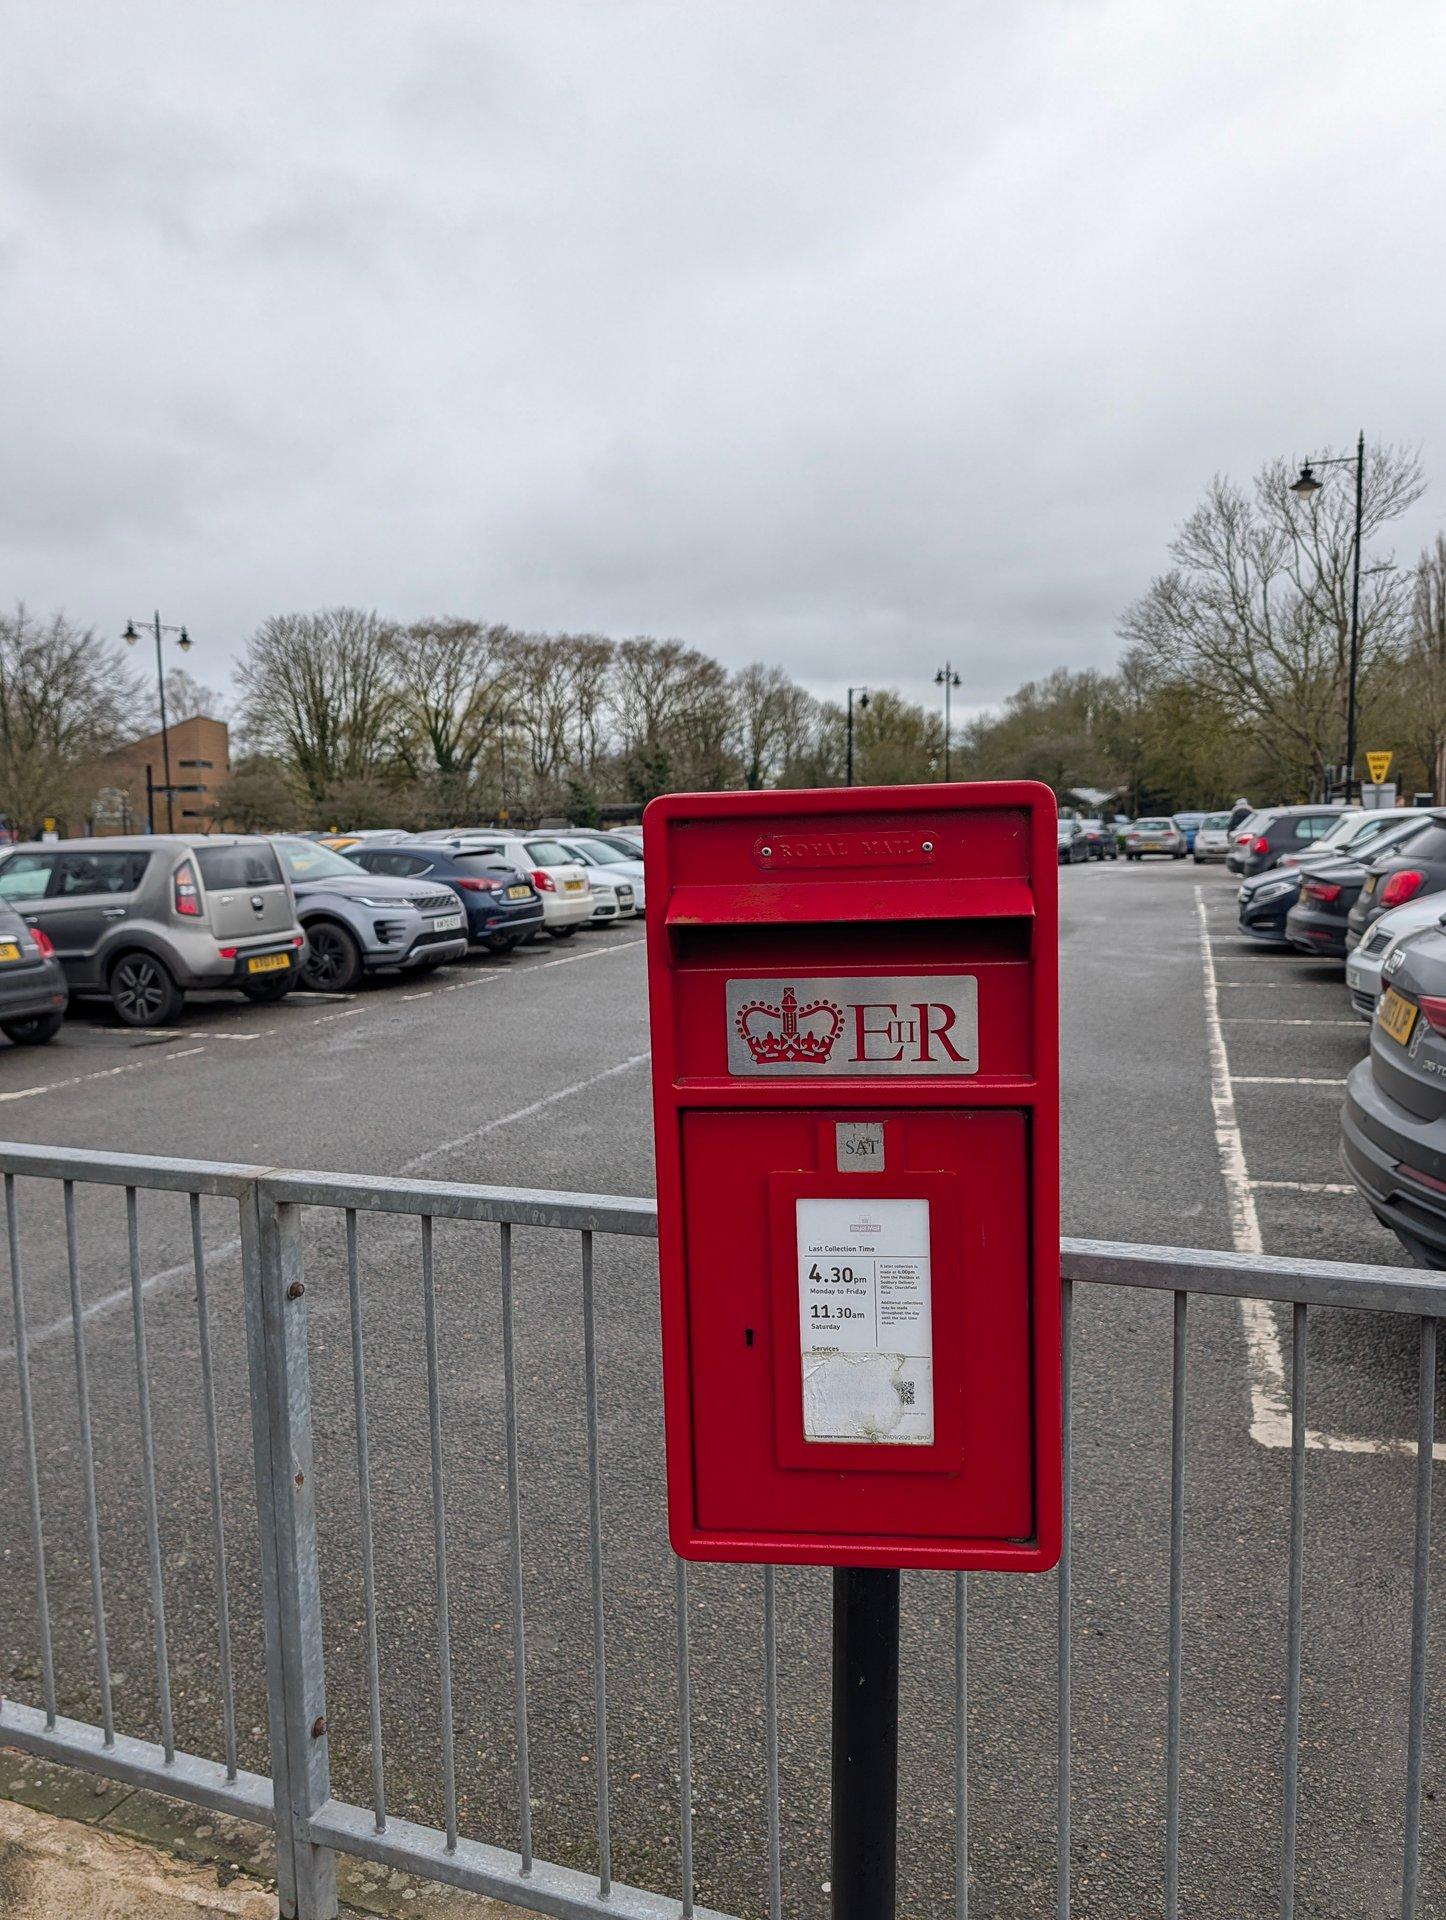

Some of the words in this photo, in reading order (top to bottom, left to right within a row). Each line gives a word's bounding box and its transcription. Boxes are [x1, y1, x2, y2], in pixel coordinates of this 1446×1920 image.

[779, 843, 848, 857] ROYAL
[845, 1139, 879, 1155] SAT
[808, 1263, 867, 1284] 4.30pm
[810, 1304, 865, 1319] 11.30am
[811, 1323, 841, 1331] Saturday
